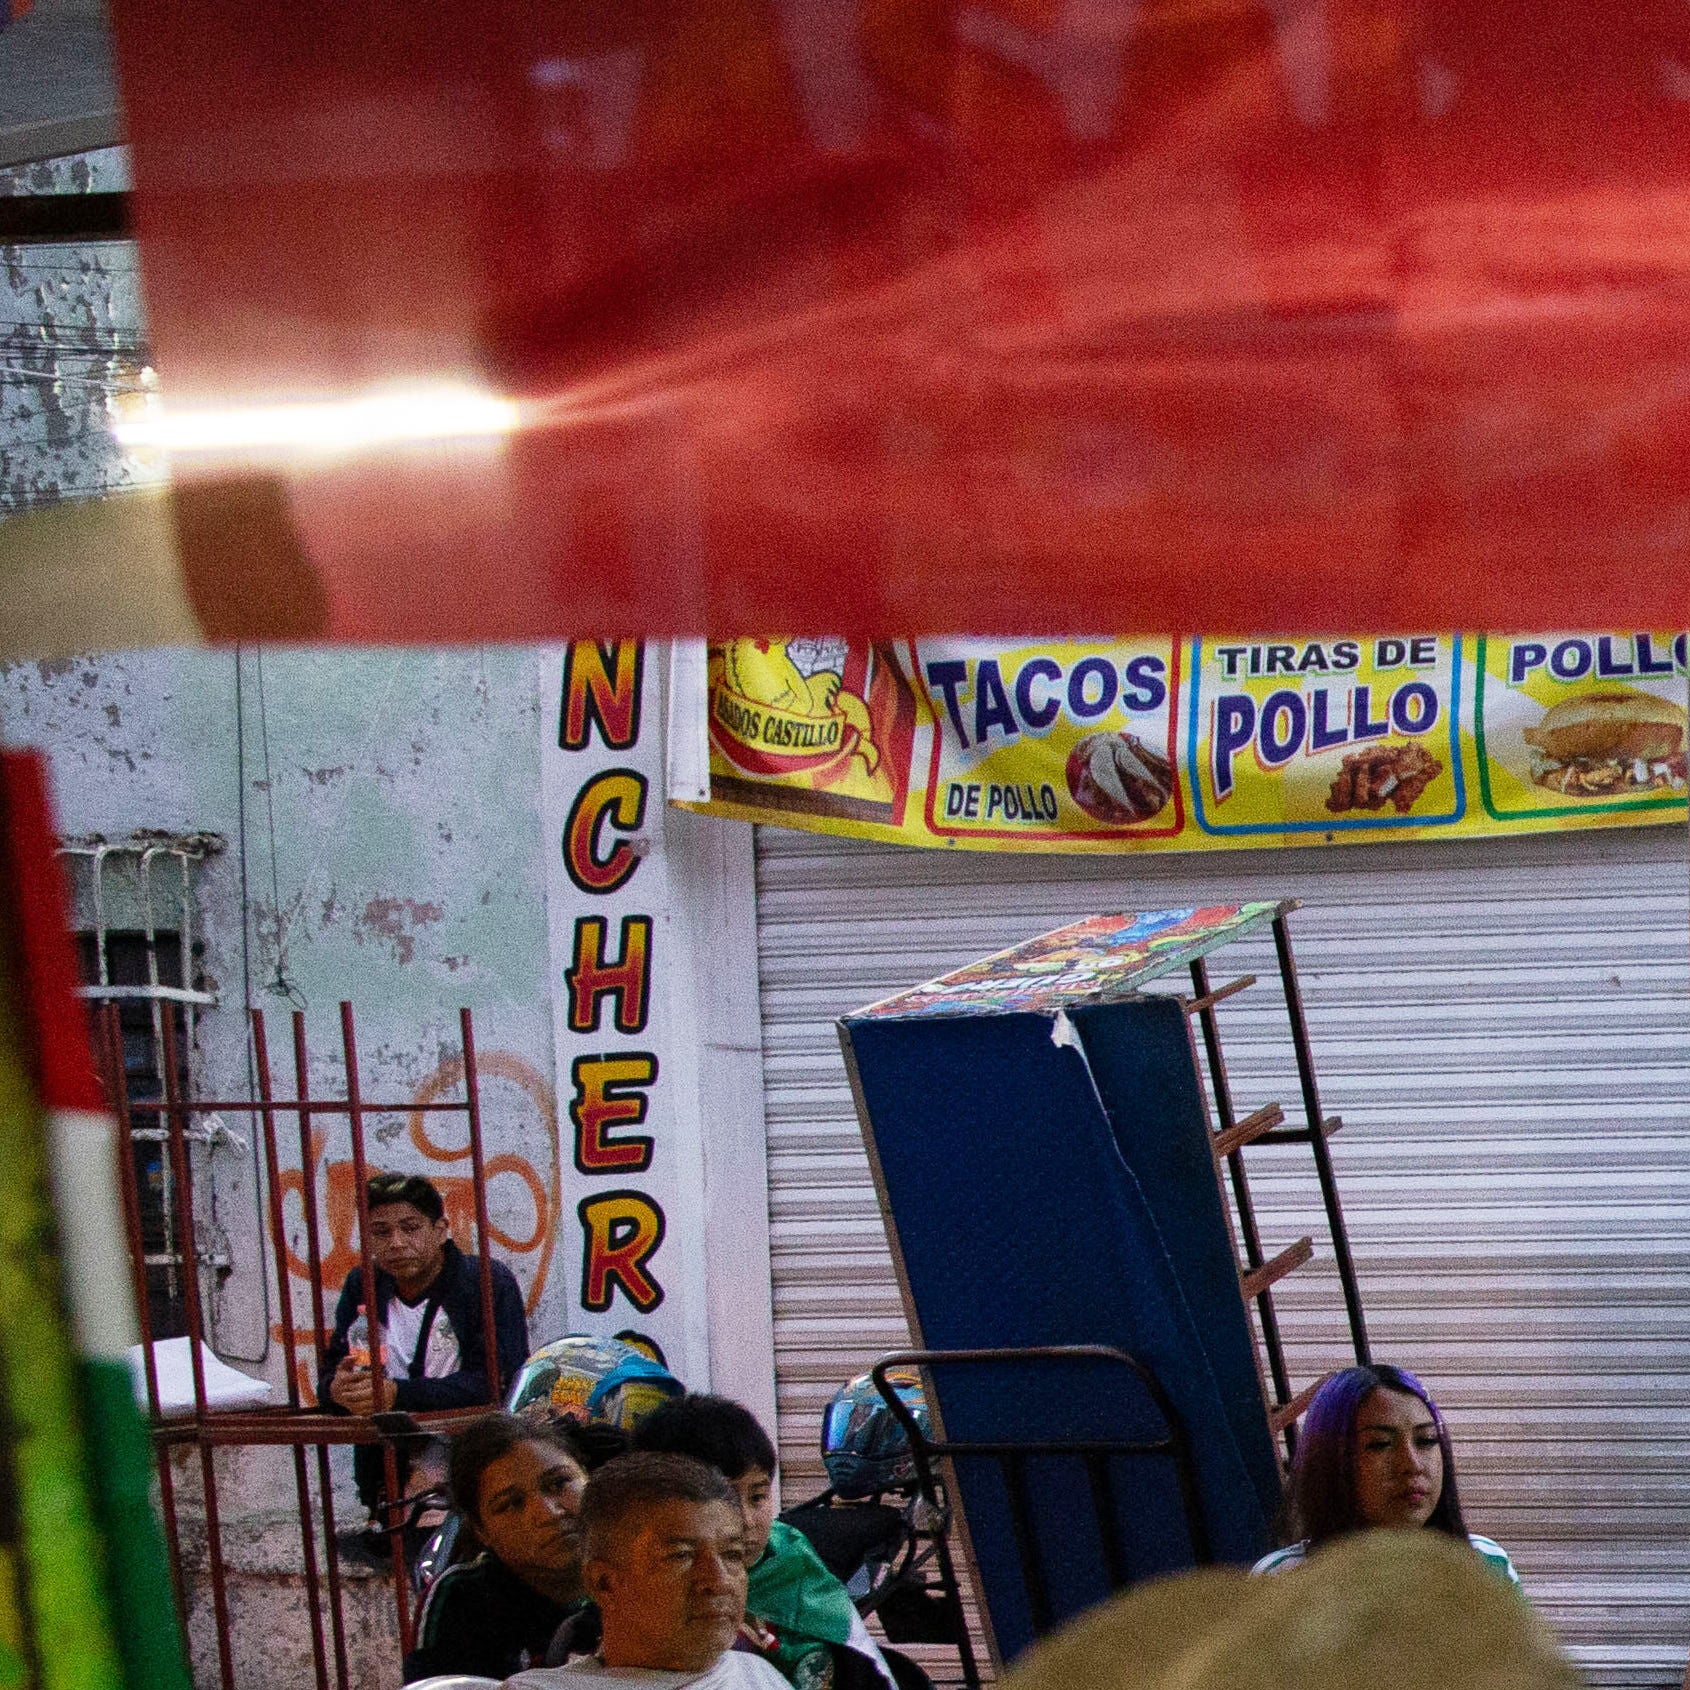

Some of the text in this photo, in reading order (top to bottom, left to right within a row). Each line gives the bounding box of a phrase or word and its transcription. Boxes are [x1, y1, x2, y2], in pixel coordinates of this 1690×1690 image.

[1217, 637, 1438, 676] TIRAS DE
[763, 715, 839, 747] CASTILLO
[927, 655, 1167, 750] TACOS
[1213, 682, 1440, 796] POLLO
[946, 783, 1058, 821] DE POLLO
[559, 636, 667, 1364] NCHER
